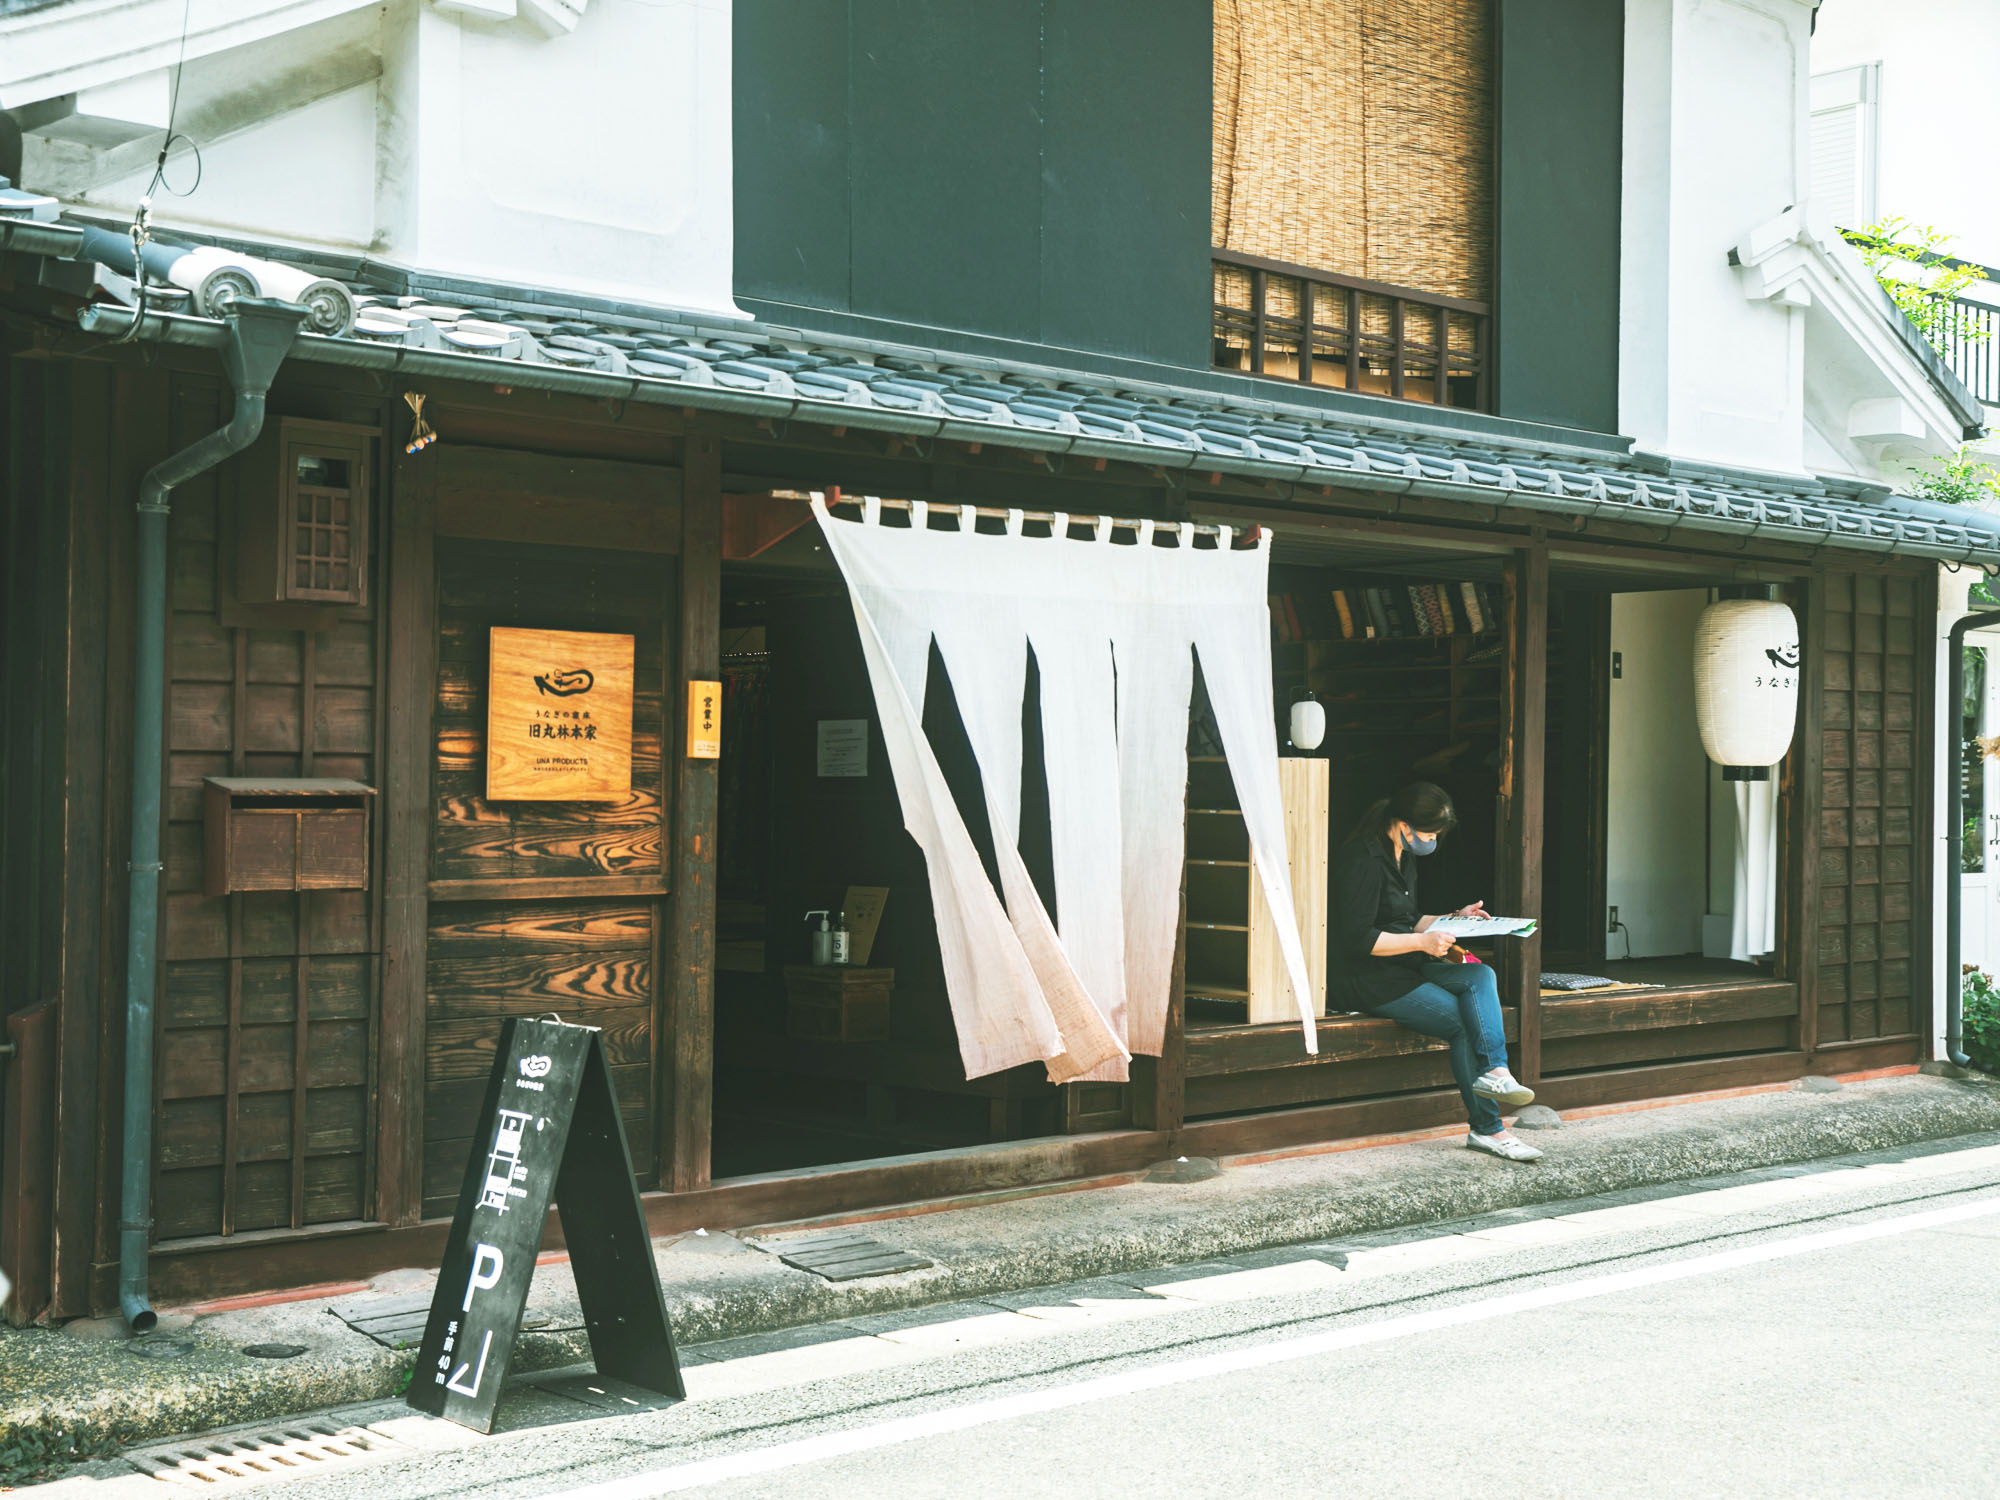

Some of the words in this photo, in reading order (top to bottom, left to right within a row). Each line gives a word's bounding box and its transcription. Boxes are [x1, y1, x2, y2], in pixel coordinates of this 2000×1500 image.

[1755, 676, 1797, 689] うなぎ
[703, 696, 713, 733] 営業中
[529, 723, 597, 740] 旧丸林本家
[552, 757, 588, 765] PRODUCTS
[462, 1242, 504, 1313] P
